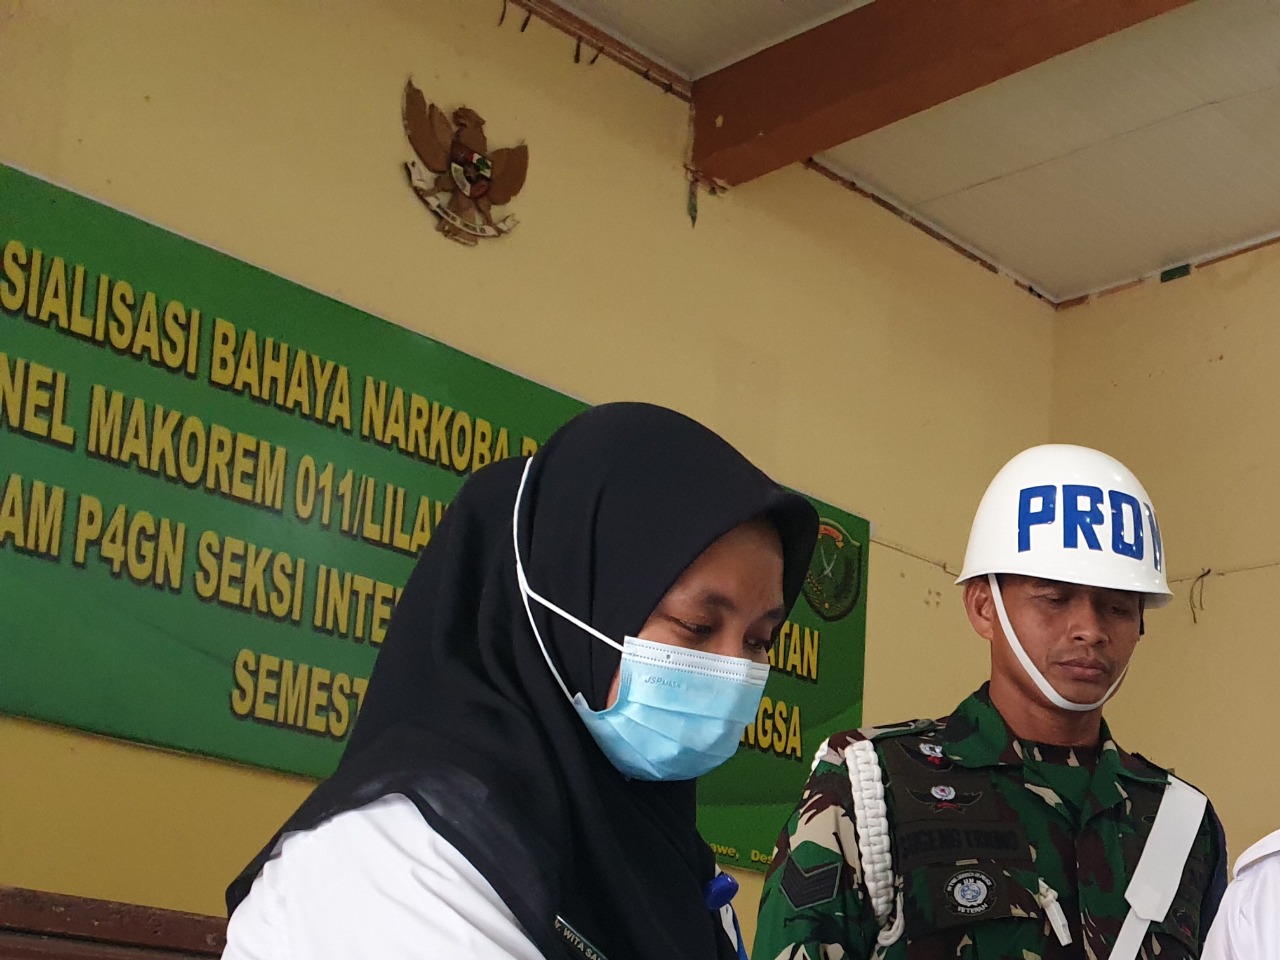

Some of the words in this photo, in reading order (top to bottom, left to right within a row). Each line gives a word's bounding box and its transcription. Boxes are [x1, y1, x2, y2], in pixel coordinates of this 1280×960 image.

[88, 384, 287, 510] MAKOREM
[295, 454, 448, 552] 011/LILA
[211, 317, 351, 429] BAHAYA
[362, 375, 510, 473] NARKOBA
[75, 493, 186, 588] P4GN
[196, 530, 305, 621] SEKSI
[313, 564, 404, 643] INTE
[563, 927, 584, 952] WITA
